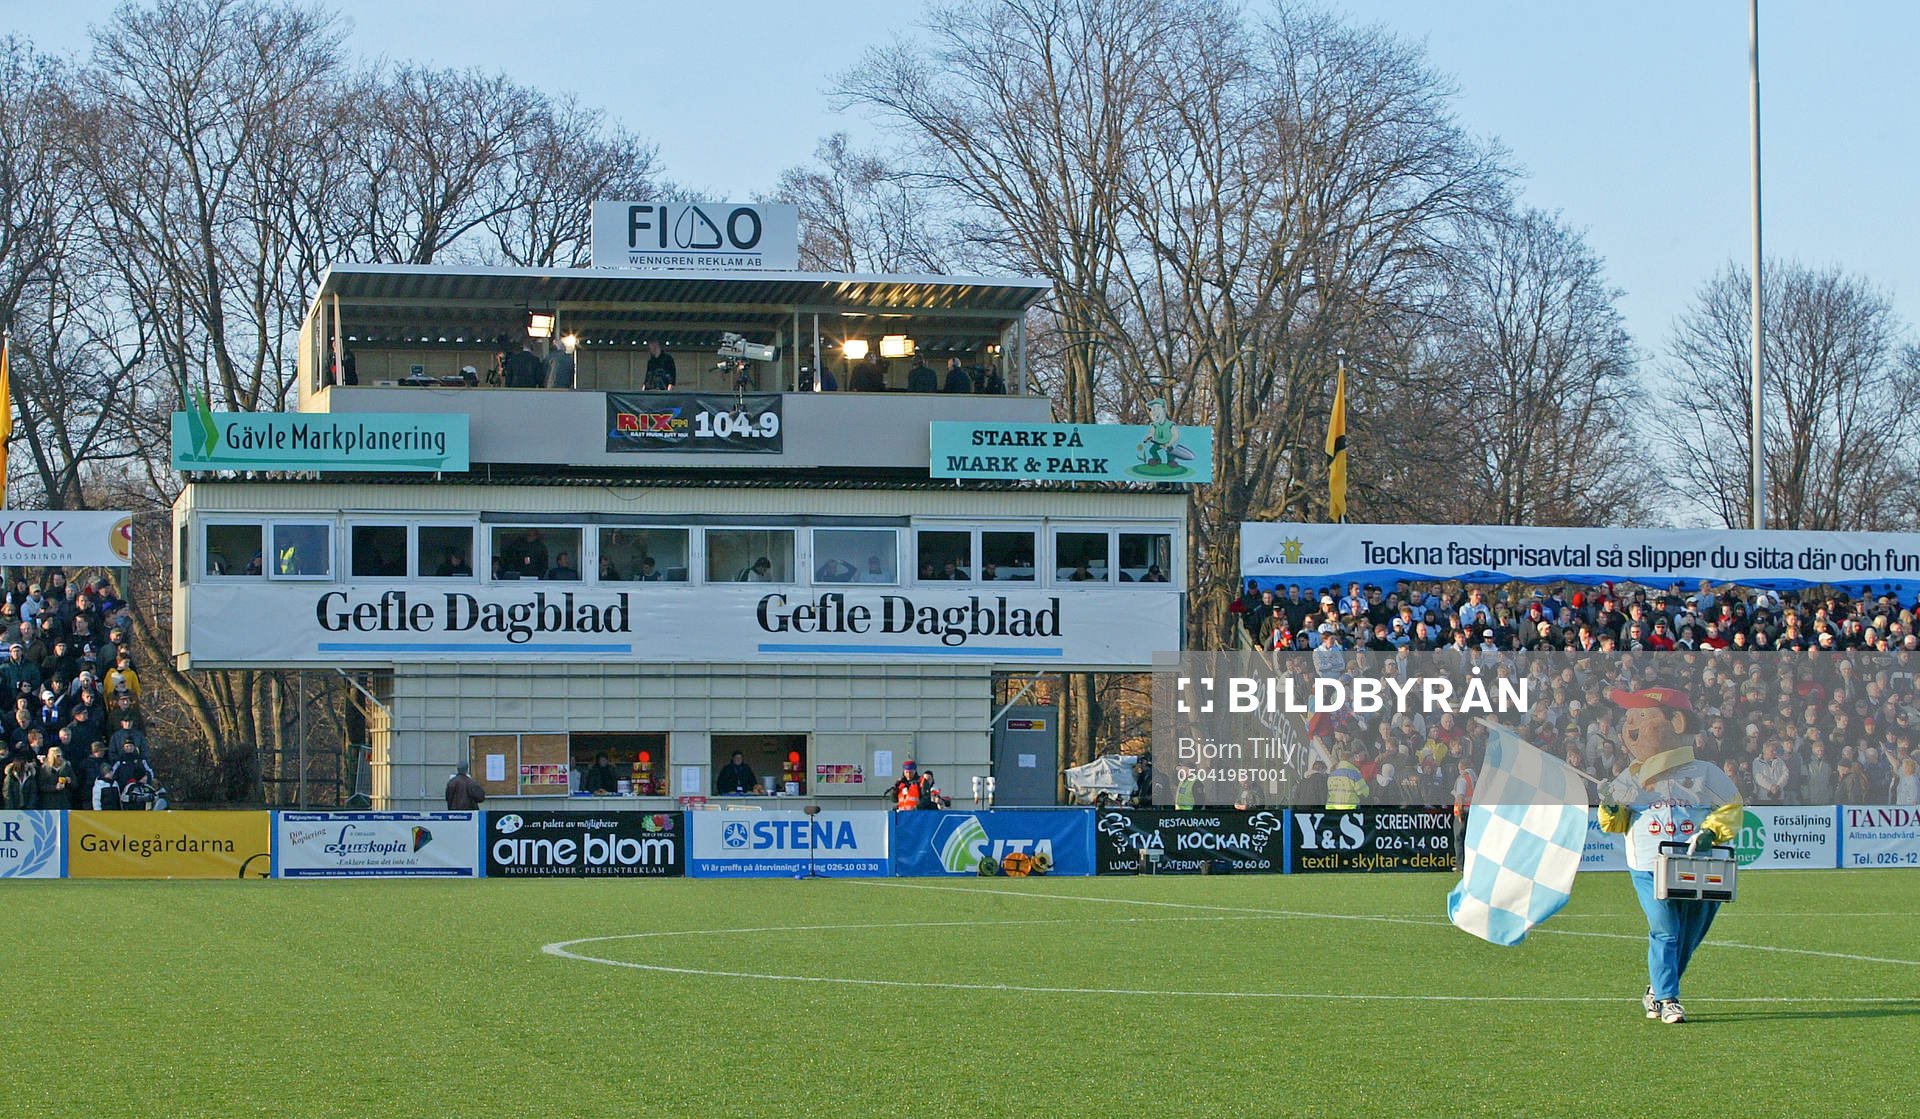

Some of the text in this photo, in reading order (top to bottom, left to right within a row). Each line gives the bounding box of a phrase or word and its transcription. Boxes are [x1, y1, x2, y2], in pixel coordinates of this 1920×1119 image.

[629, 256, 762, 266] WENNGREN REKLAM AB
[617, 413, 674, 431] RIX
[695, 411, 779, 438] 104.9
[226, 423, 445, 455] Gävle Markplanering
[972, 427, 1083, 447] STARK PÅ
[947, 456, 1108, 474] MARK & PARK
[1258, 555, 1284, 564] GÄVLE
[1361, 541, 1919, 573] Teckna fastprisavtal så slipper du sitta där och fun
[317, 591, 632, 643] Gefle Dagblad
[757, 593, 1062, 646] Gefle Dagblad
[542, 819, 564, 830] palett
[577, 819, 618, 830] möjligheter
[1159, 818, 1220, 828] RESTAURANG
[1375, 814, 1452, 830] SCREENTRYCK
[1773, 814, 1831, 828] Försäljning
[0, 821, 24, 841] R
[753, 821, 857, 849] STENA
[1129, 830, 1250, 850] TVÅ KOCKAR
[1294, 813, 1365, 849] Y&S
[1773, 832, 1825, 844] Uthyrning
[1879, 831, 1914, 839] tandvård
[80, 834, 234, 857] Gavlegårdarna
[493, 833, 675, 865] arne blom
[1375, 836, 1448, 849] 026-14 08
[965, 840, 1054, 873] SITA
[1302, 853, 1338, 868] textil
[1351, 853, 1399, 871] skyltar
[1580, 854, 1604, 862] ladet
[1773, 848, 1811, 859] Service
[1852, 853, 1872, 864] Tel.
[505, 866, 576, 874] PROFILKLÄDER
[585, 866, 665, 874] PRESENTREKLAM
[720, 863, 742, 872] proffs
[743, 864, 754, 872] på
[754, 863, 799, 872] återvinning!
[827, 863, 854, 871] 026-10
[1163, 860, 1207, 870] ATERIN
[1245, 861, 1257, 869] 60
[1258, 860, 1271, 869] 60
